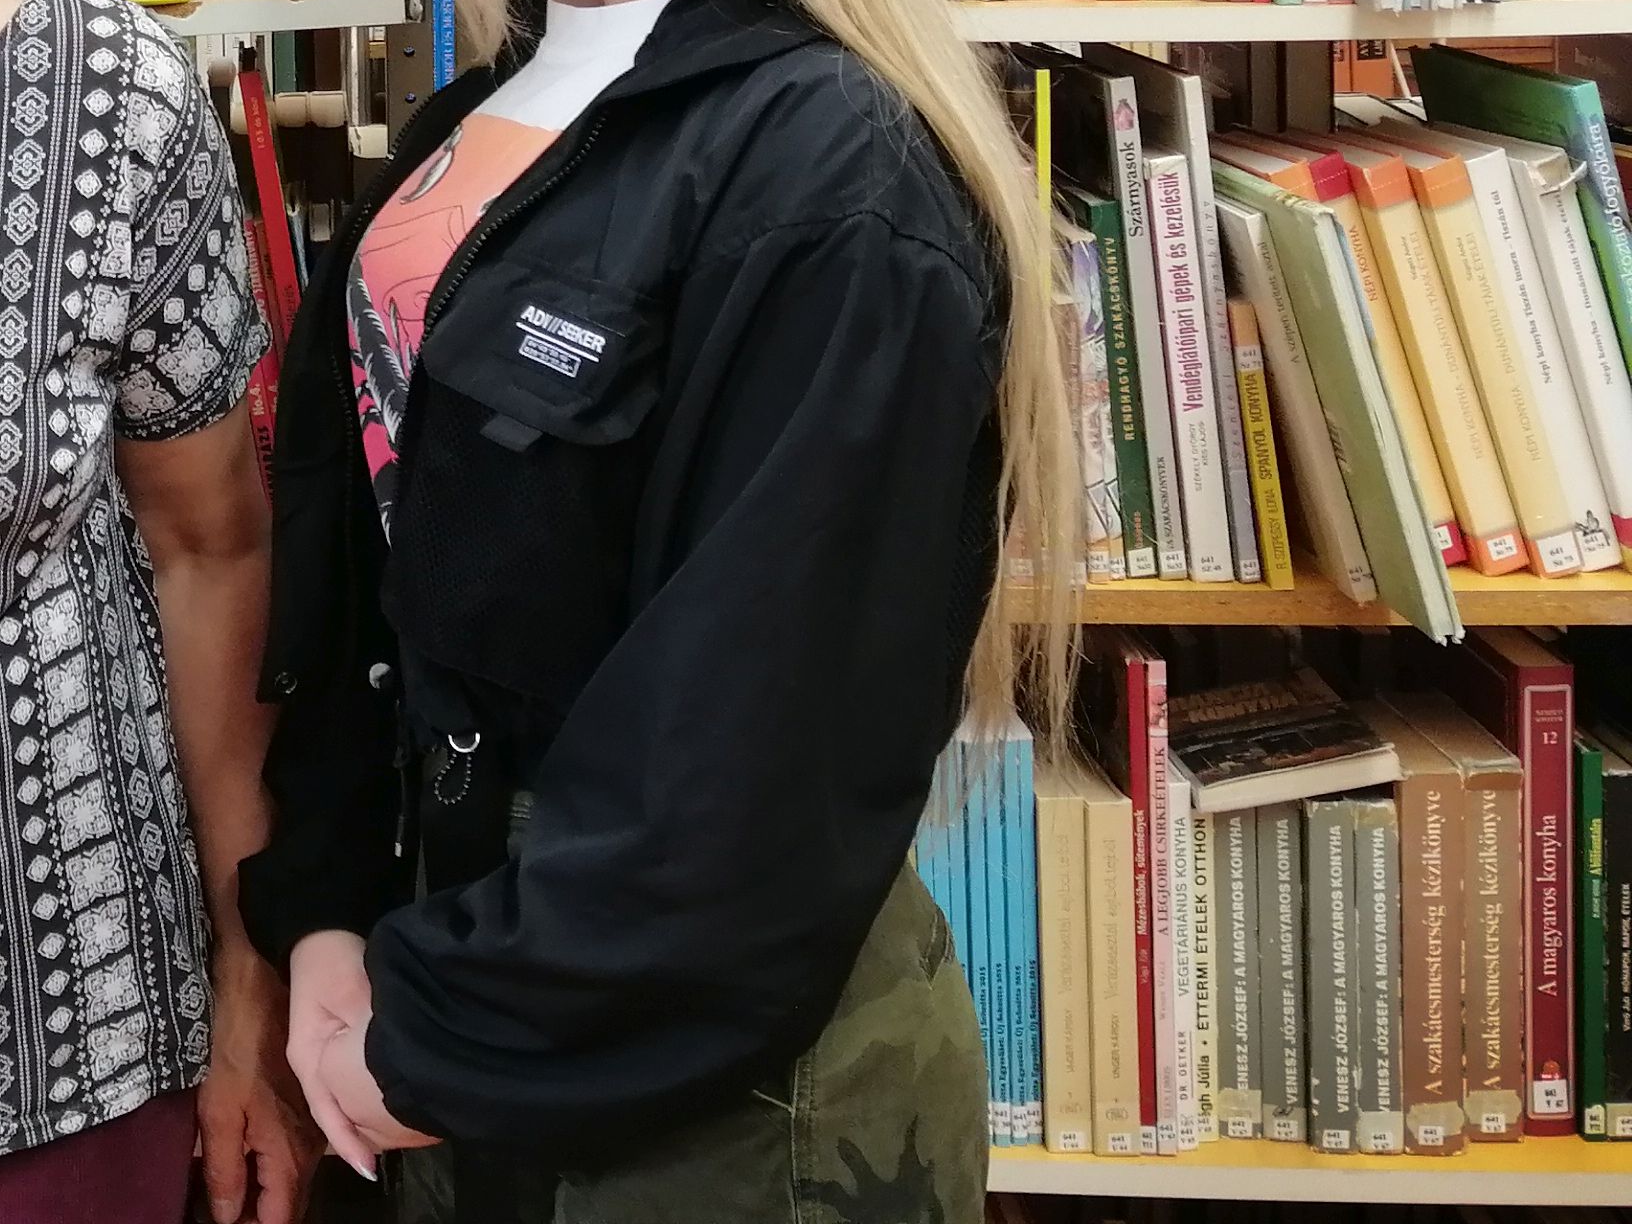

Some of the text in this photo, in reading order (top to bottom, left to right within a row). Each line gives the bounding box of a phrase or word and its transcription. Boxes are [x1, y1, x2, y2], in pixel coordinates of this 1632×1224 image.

[1120, 142, 1144, 238] Szárnyasok
[1158, 172, 1204, 413] Vendéglátóipari gépek és kezelésük
[1152, 747, 1168, 855] CSIRKEÉTELEK
[1542, 731, 1558, 745] 12
[1174, 817, 1190, 997] VEGETÁRIÁNUS KONYHA
[1194, 818, 1209, 954] ÉTELEK OTTHON
[1229, 816, 1246, 964] MAGYAROS KONYHA
[1276, 818, 1298, 1105] VENESZ MAGYAROS KONYHA
[1328, 825, 1349, 1113] VENESZ MAGYAROS KONYHA
[1370, 827, 1388, 977] MAGYAROS KONYHA
[1421, 789, 1447, 1073] szakácsmesterség kézikönyve
[1478, 789, 1504, 1070] szakácsmesterség kézikönyve
[1536, 814, 1564, 997] A magyaros konyha
